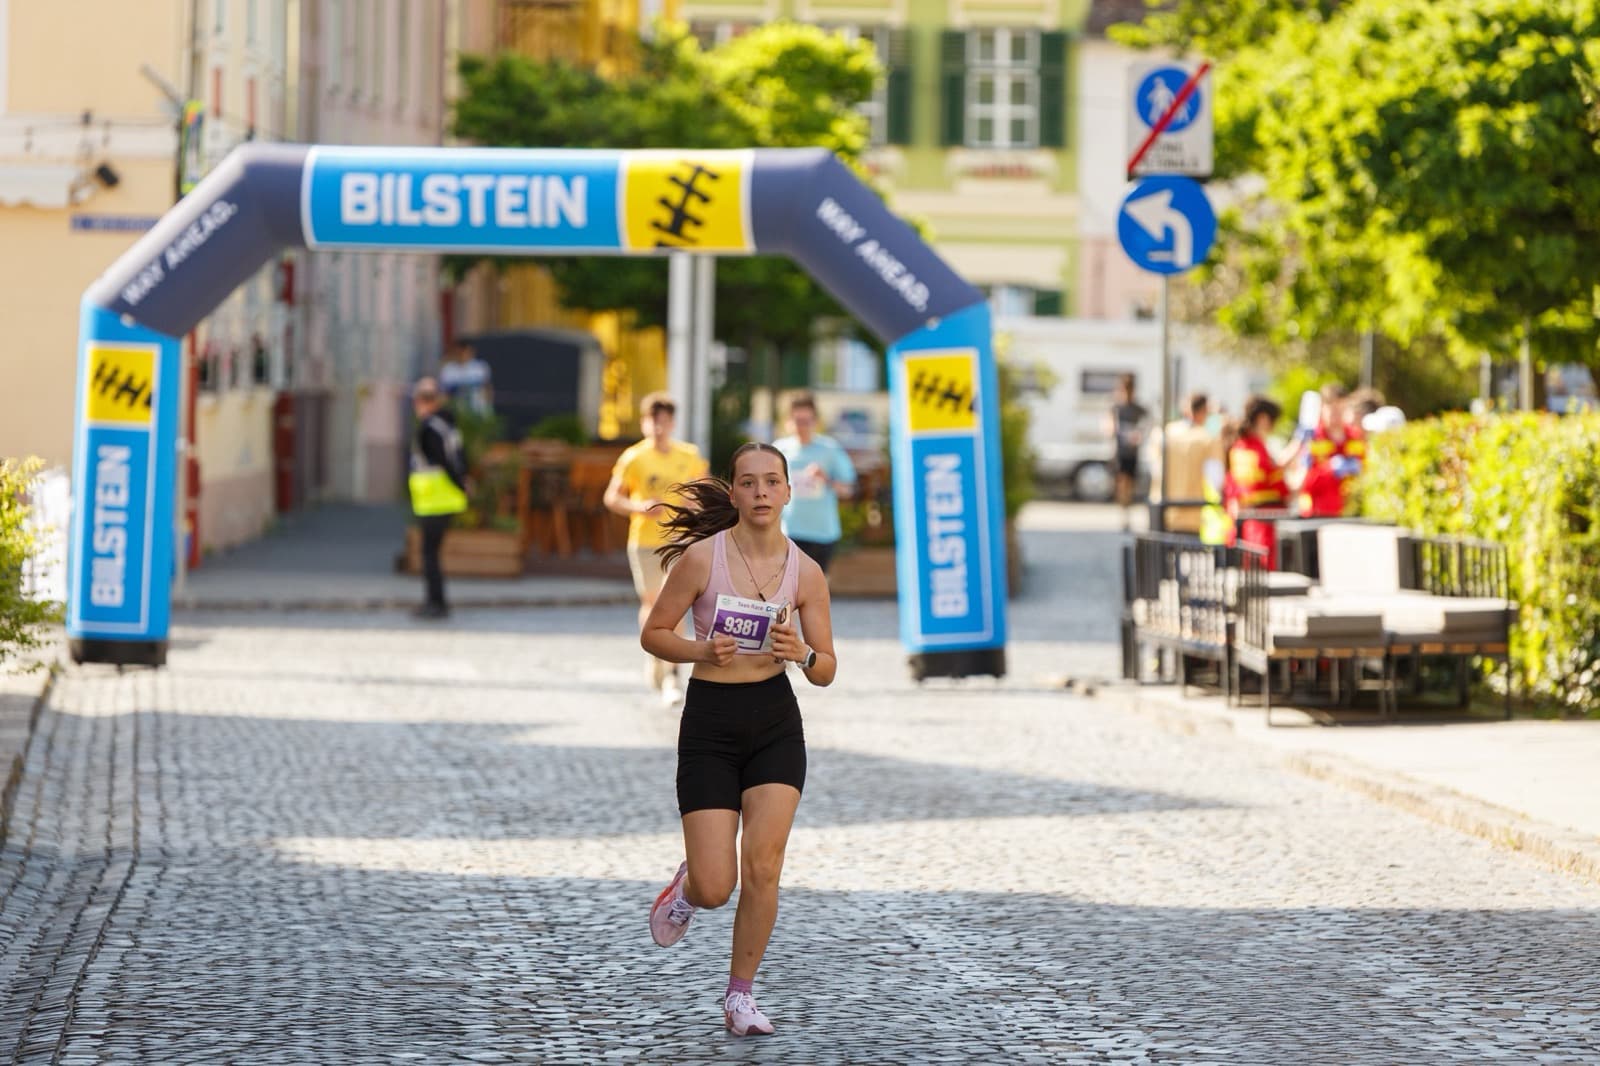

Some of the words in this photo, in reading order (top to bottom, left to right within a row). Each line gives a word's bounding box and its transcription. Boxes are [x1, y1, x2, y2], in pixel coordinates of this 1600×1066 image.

[341, 172, 588, 228] BILSTEIN
[816, 197, 867, 244] WAY
[854, 239, 929, 312] AHEAD.
[91, 444, 132, 607] BILSTEIN
[923, 453, 969, 618] BILSTEIN
[723, 616, 760, 637] 9381
